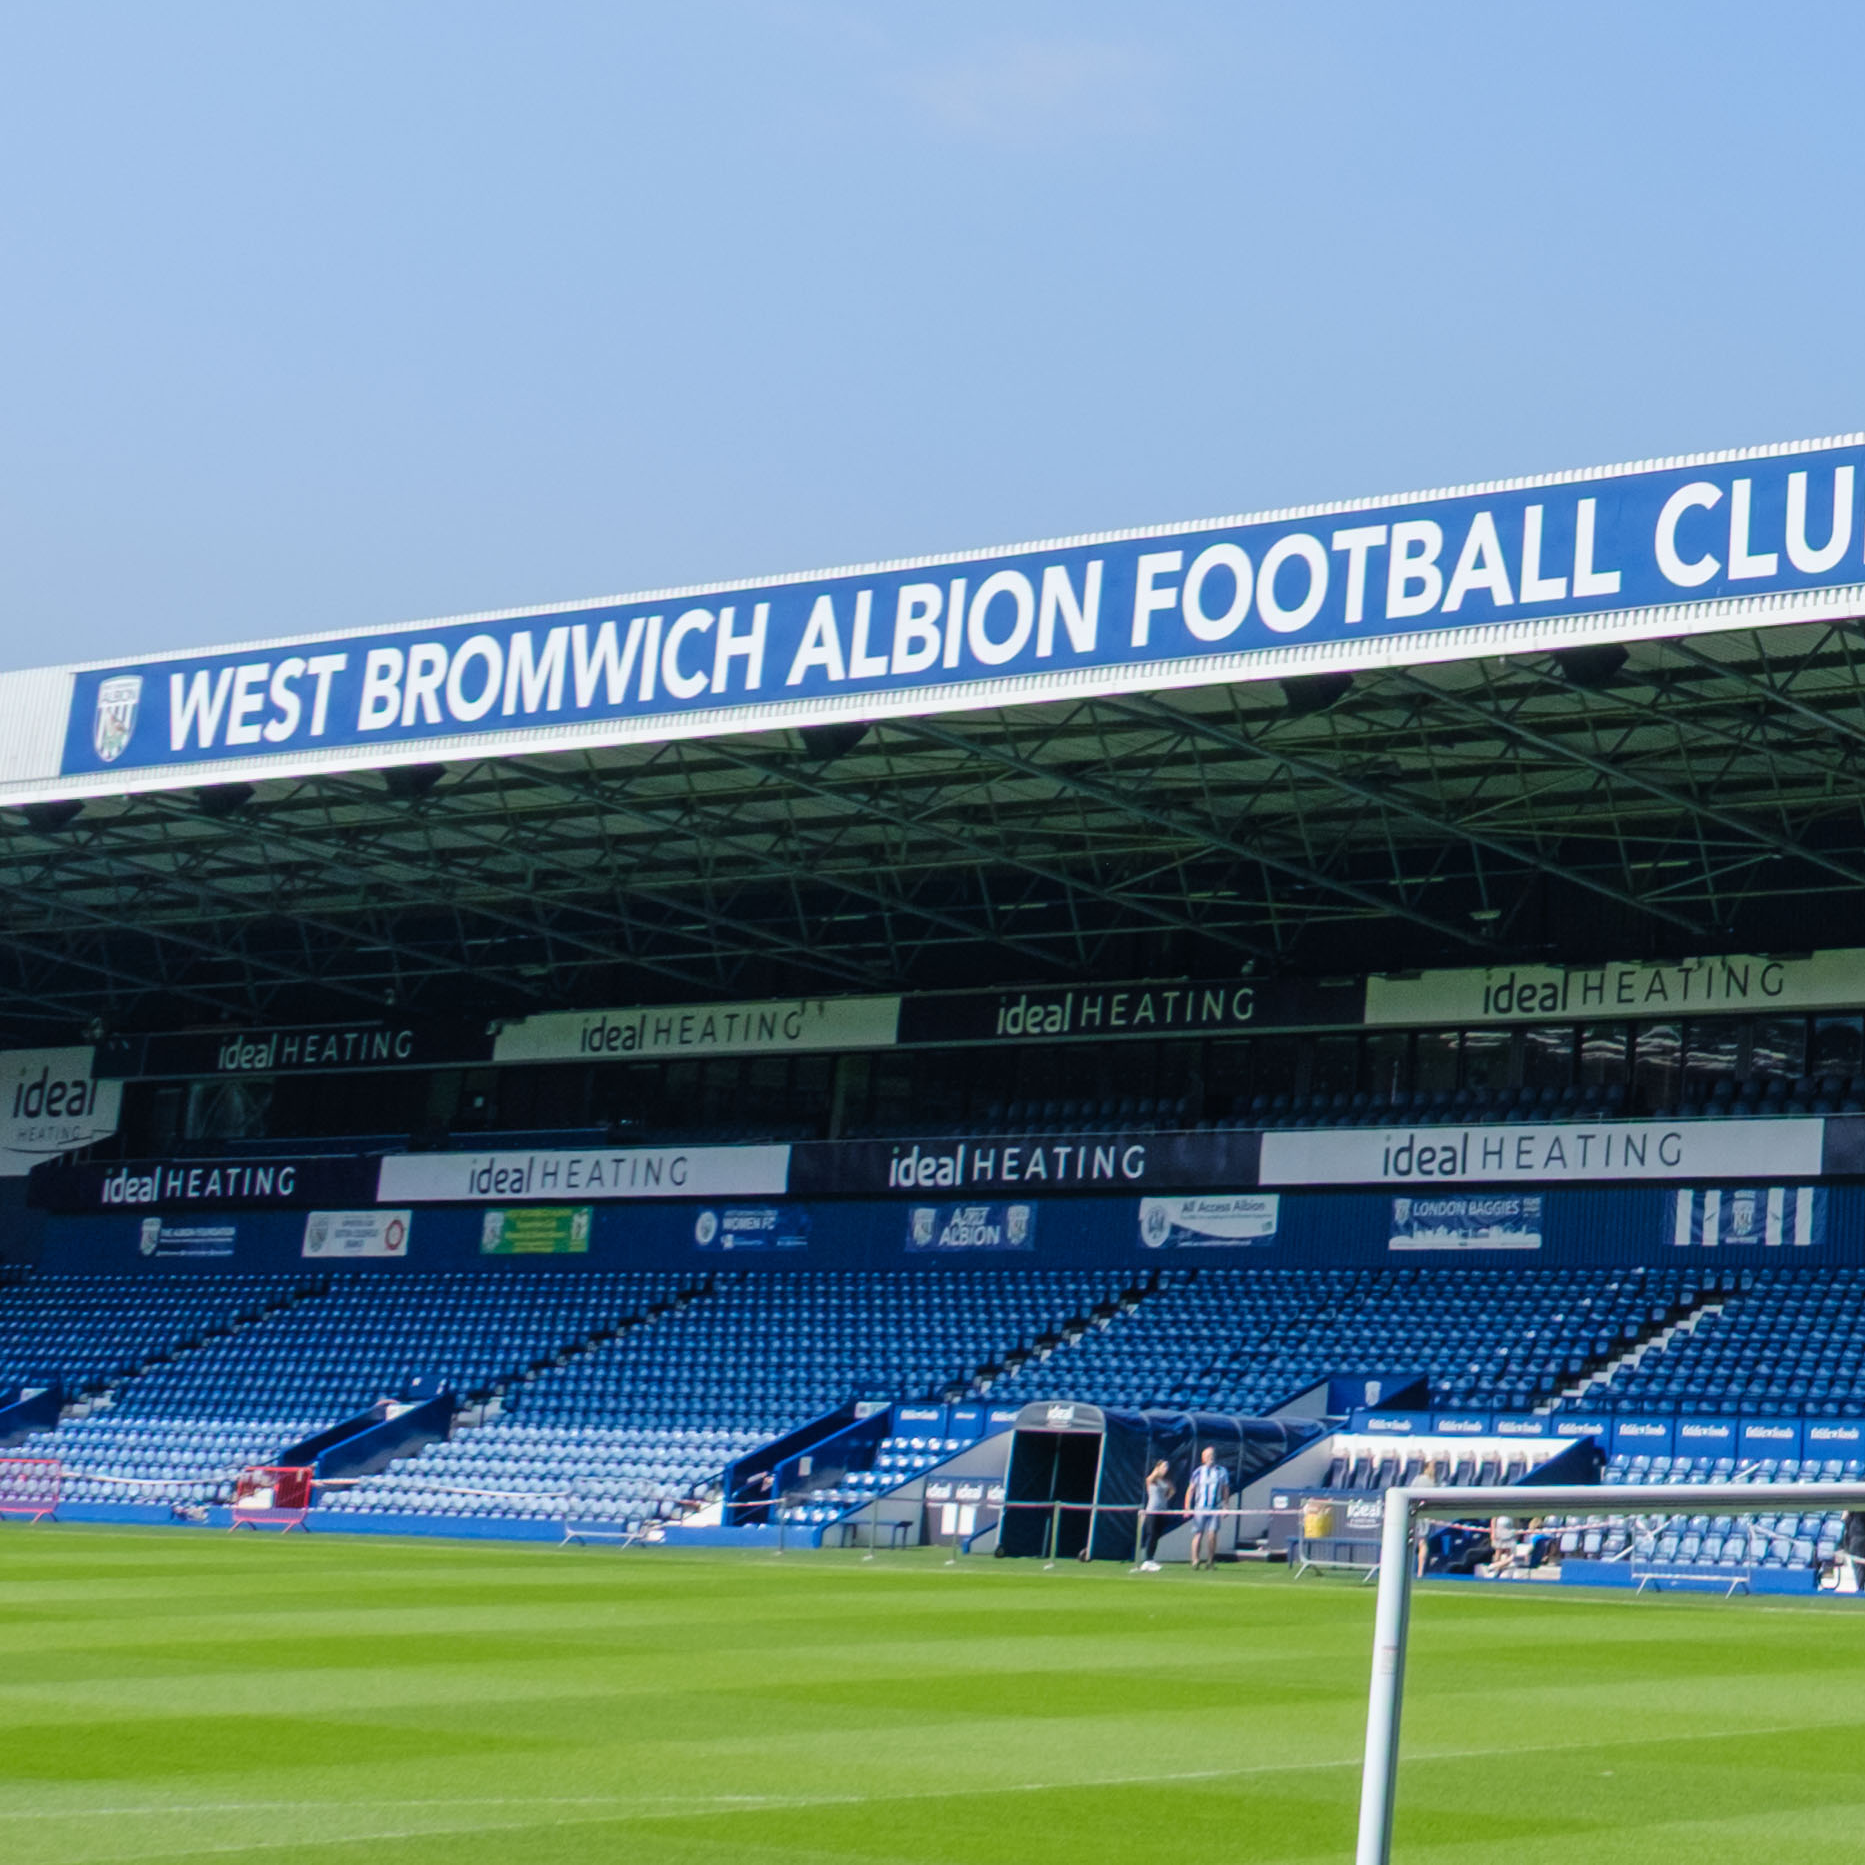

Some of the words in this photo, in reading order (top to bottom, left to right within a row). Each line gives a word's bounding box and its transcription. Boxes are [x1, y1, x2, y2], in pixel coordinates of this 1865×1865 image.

[169, 653, 348, 751] WEST
[356, 602, 771, 730] BROMWICH
[786, 559, 1102, 687] ALBION
[1131, 498, 1622, 649] FOOTBALL
[1482, 969, 1569, 1015] ideal
[1581, 961, 1785, 1005] HEATING
[998, 993, 1071, 1035] ideal
[1081, 987, 1255, 1027] HEATING
[218, 1035, 275, 1070] ideal
[282, 1031, 412, 1064] HEATING
[580, 1015, 646, 1054] ideal
[654, 1011, 802, 1046] HEATING
[11, 1065, 98, 1119] ideal
[469, 1156, 533, 1195] ideal
[541, 1155, 688, 1190] HEATING
[889, 1145, 962, 1187] ideal
[972, 1144, 1146, 1183] HEATING
[1382, 1133, 1468, 1177] ideal
[1481, 1132, 1682, 1173] HEATING
[103, 1166, 158, 1204] ideal
[166, 1166, 295, 1199] HEATING
[1198, 1202, 1232, 1213] Access
[1233, 1199, 1266, 1212] Albion
[1413, 1200, 1466, 1217] LONDON
[1468, 1200, 1521, 1216] BAGGIES
[938, 1225, 1001, 1247] ALBION
[1347, 1500, 1382, 1519] ideal
